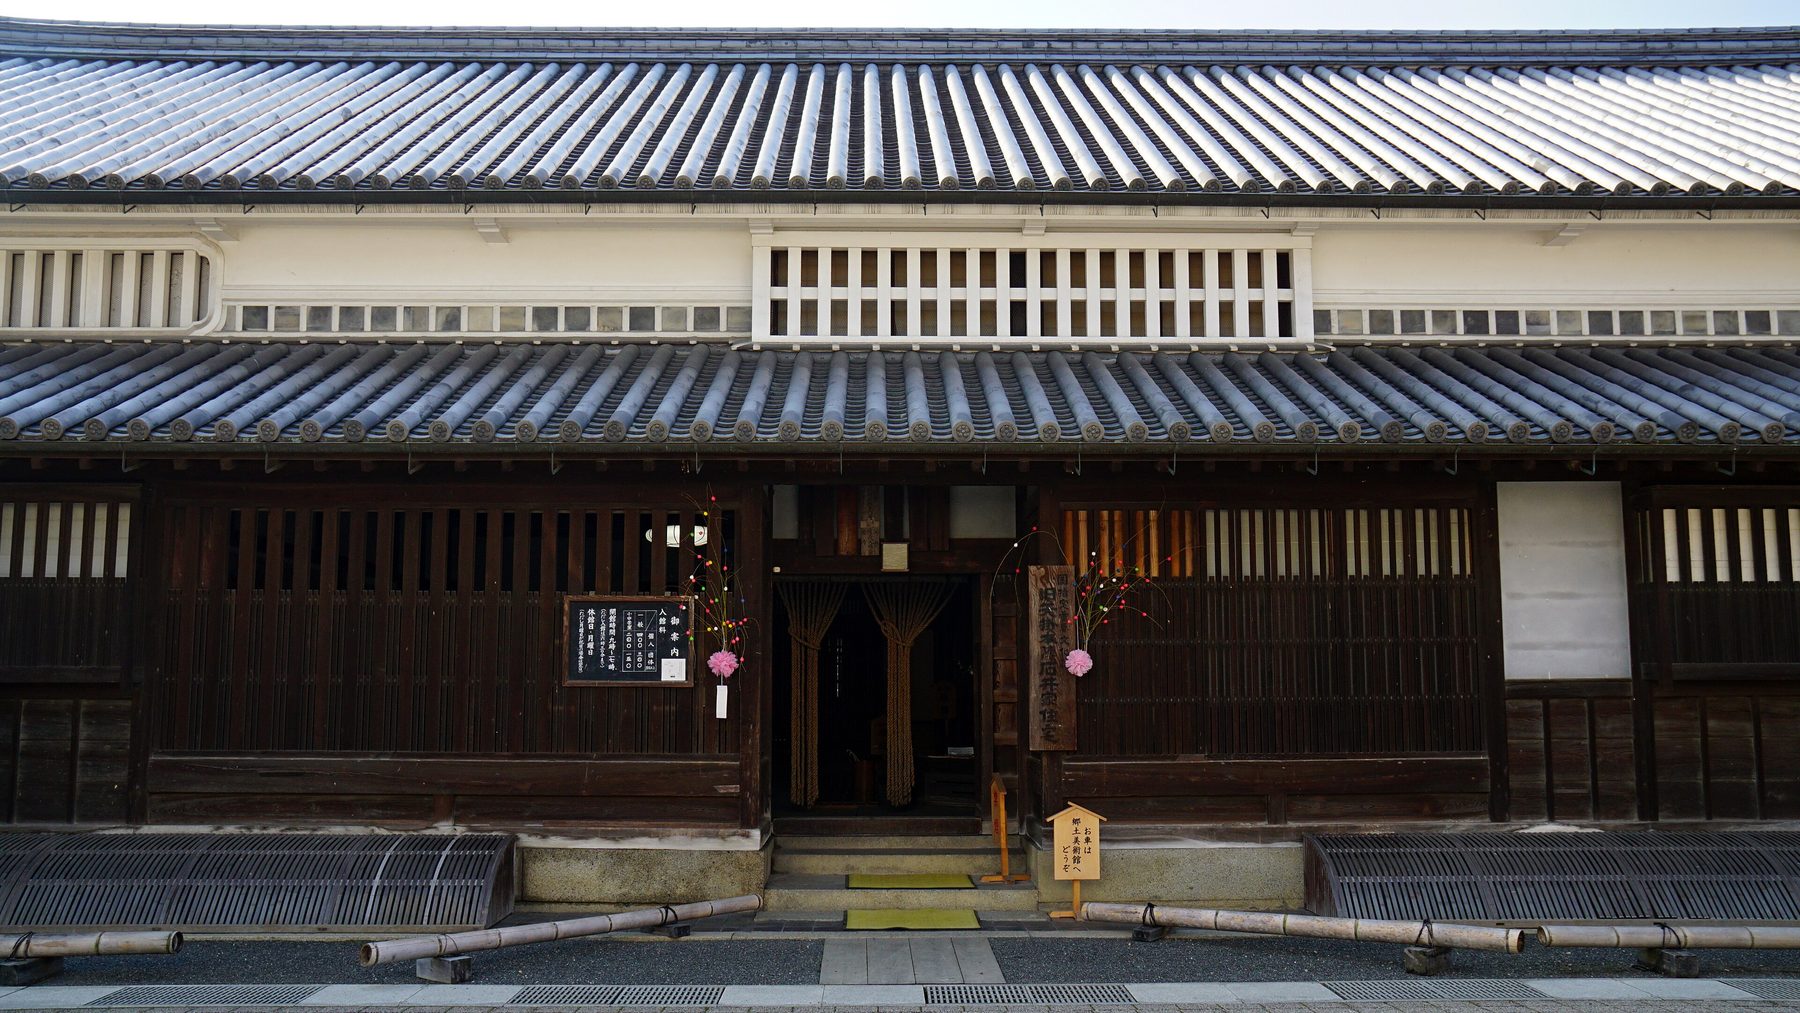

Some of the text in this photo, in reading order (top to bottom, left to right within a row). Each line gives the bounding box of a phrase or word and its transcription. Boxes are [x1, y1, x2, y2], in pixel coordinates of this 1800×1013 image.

[637, 613, 644, 628] 一般
[659, 608, 667, 634] 入館料
[671, 615, 679, 657] 御案内
[1072, 817, 1081, 872] 郷土美術館へ
[1084, 828, 1092, 854] お車は
[1063, 846, 1071, 873] どうぞ
